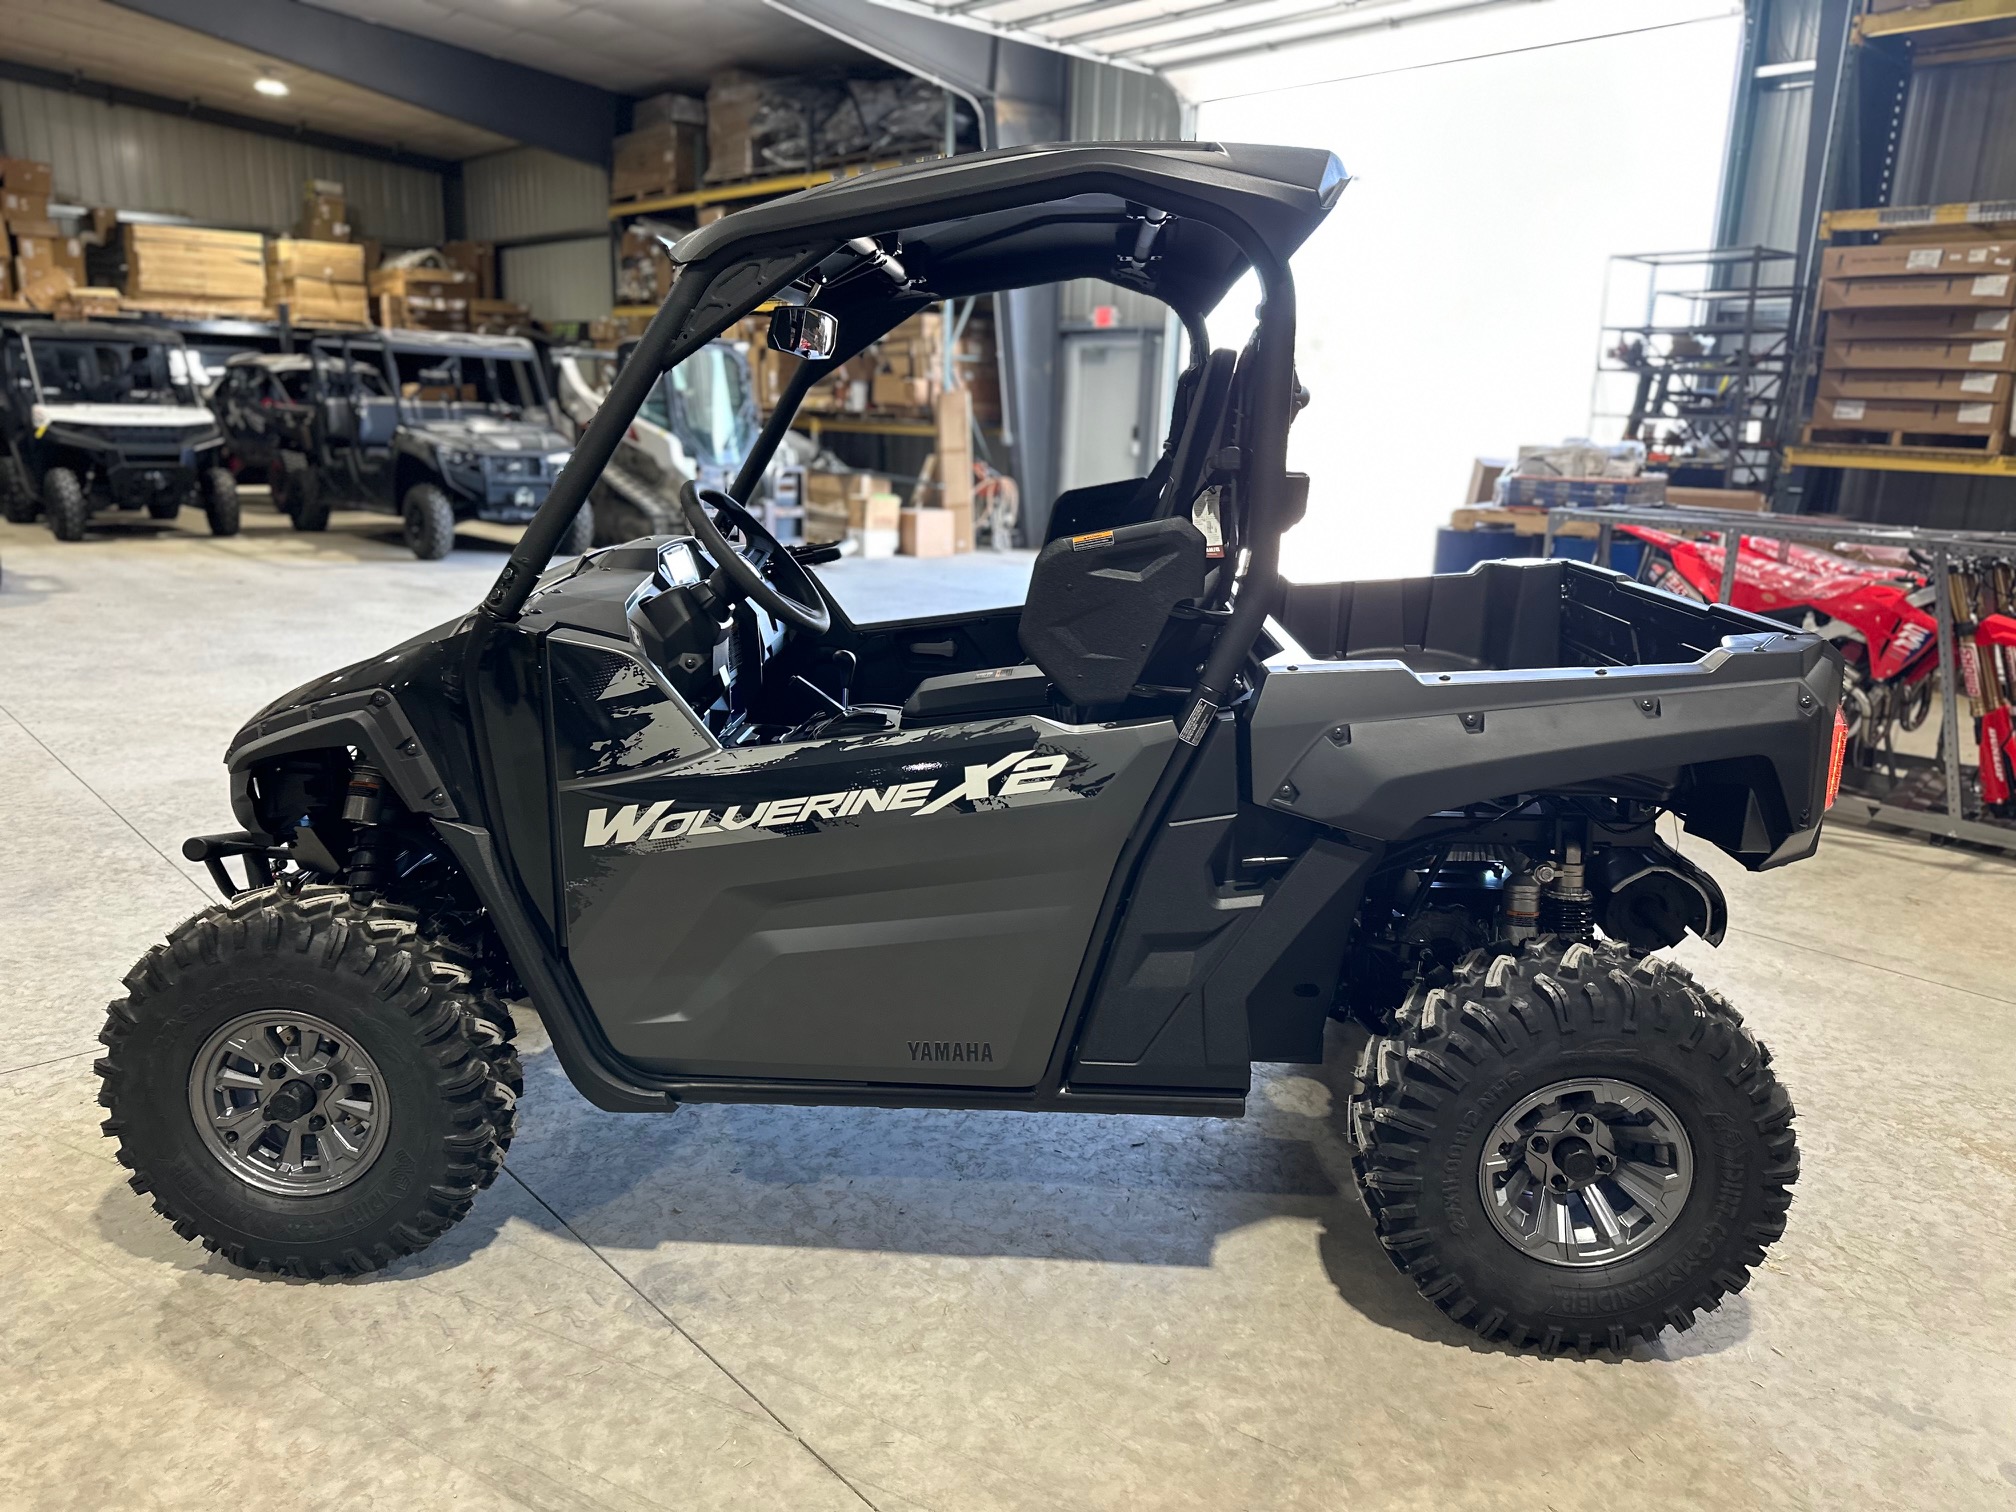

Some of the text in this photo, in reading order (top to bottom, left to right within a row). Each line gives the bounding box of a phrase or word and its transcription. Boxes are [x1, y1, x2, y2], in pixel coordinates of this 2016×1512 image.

[1961, 647, 1979, 697] SHOWA
[1988, 726, 2004, 781] DUNLOP
[583, 750, 1070, 848] WOLVERINE X2
[907, 1041, 994, 1062] YAMAHA
